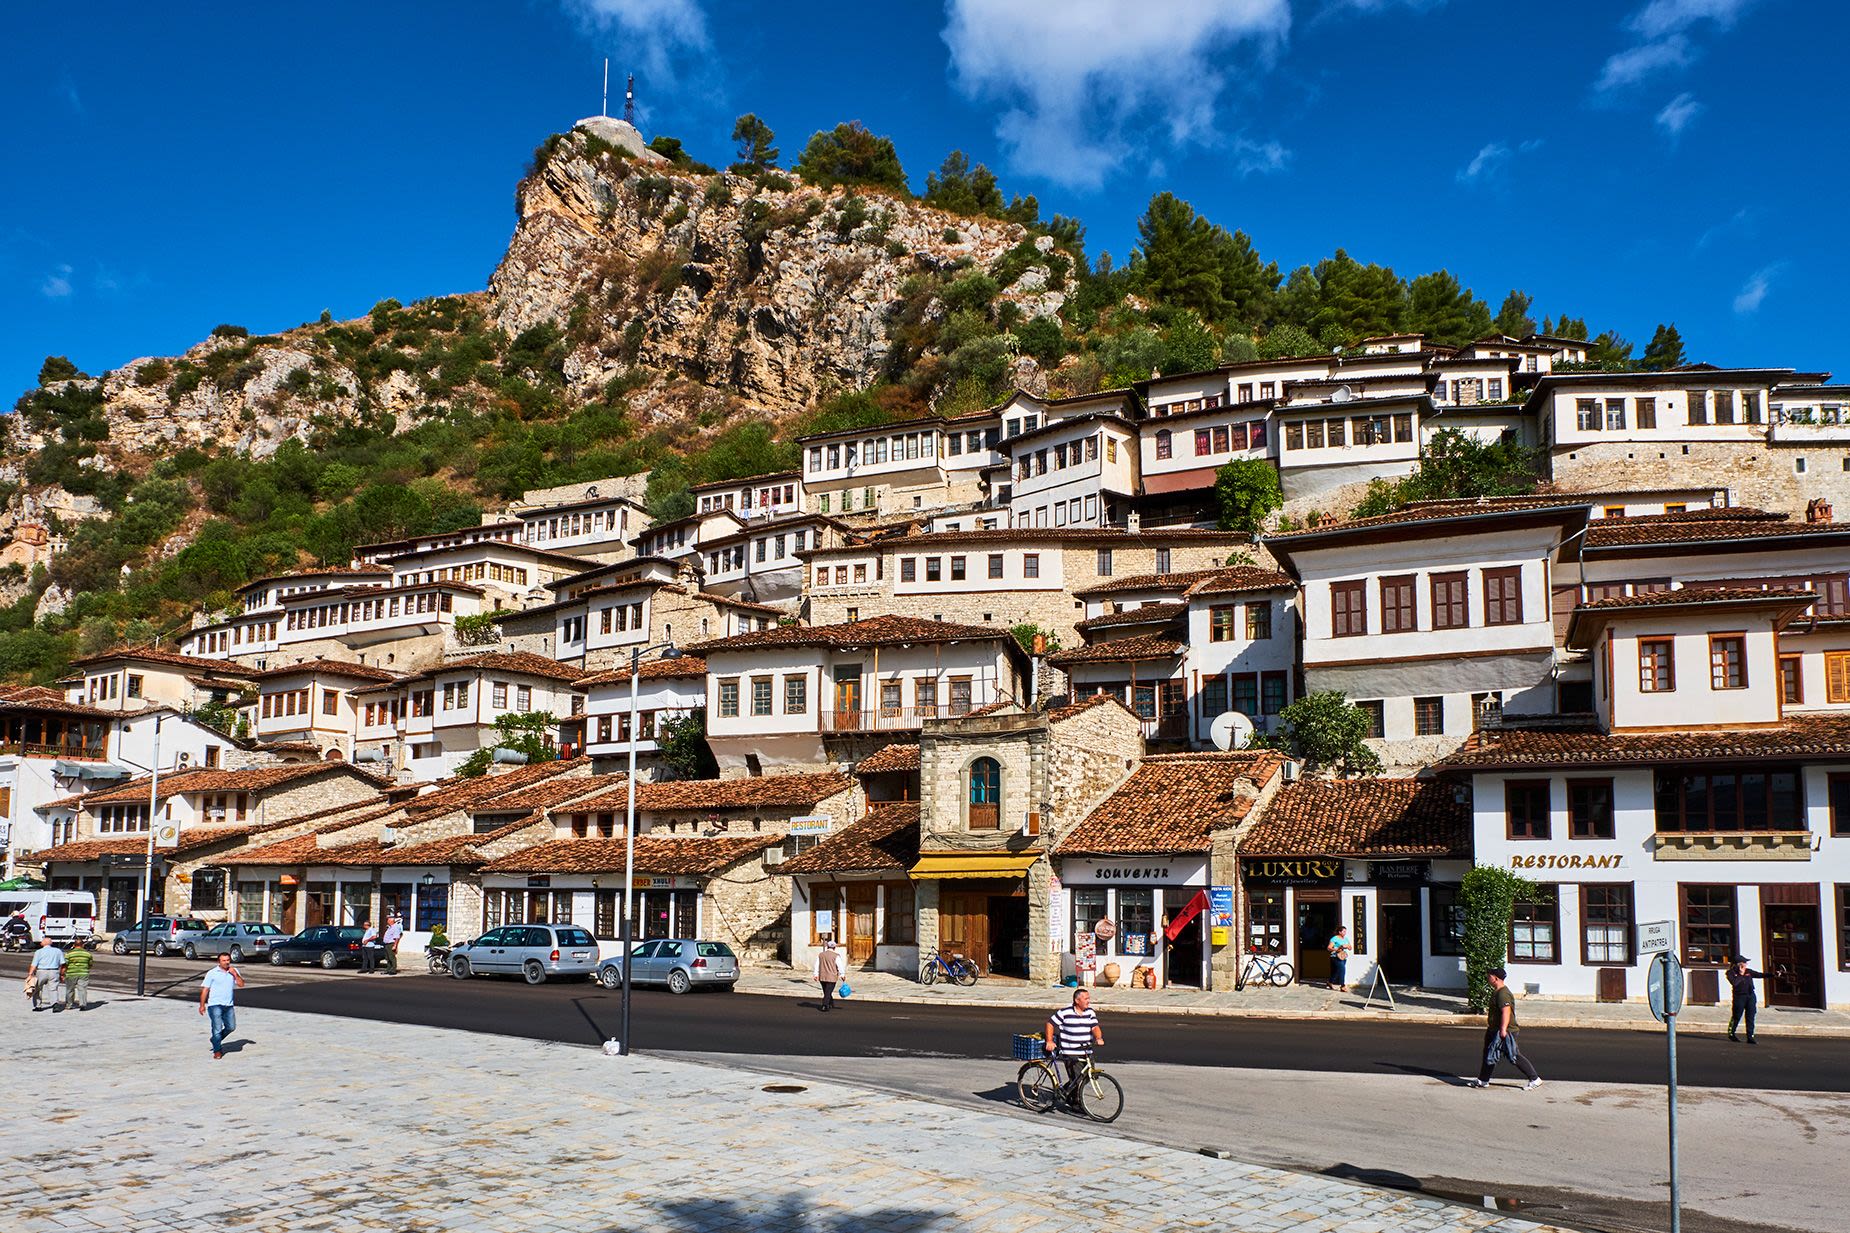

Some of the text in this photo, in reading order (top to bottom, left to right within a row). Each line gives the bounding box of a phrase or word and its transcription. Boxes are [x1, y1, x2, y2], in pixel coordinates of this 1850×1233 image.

[791, 820, 828, 830] RESTORANT
[1511, 855, 1623, 869] RESTORANT
[1095, 868, 1169, 879] SOUVENIR
[1248, 861, 1339, 878] LUXURY
[1648, 926, 1661, 934] RRUGA
[1641, 937, 1668, 949] ANTIPATREA
